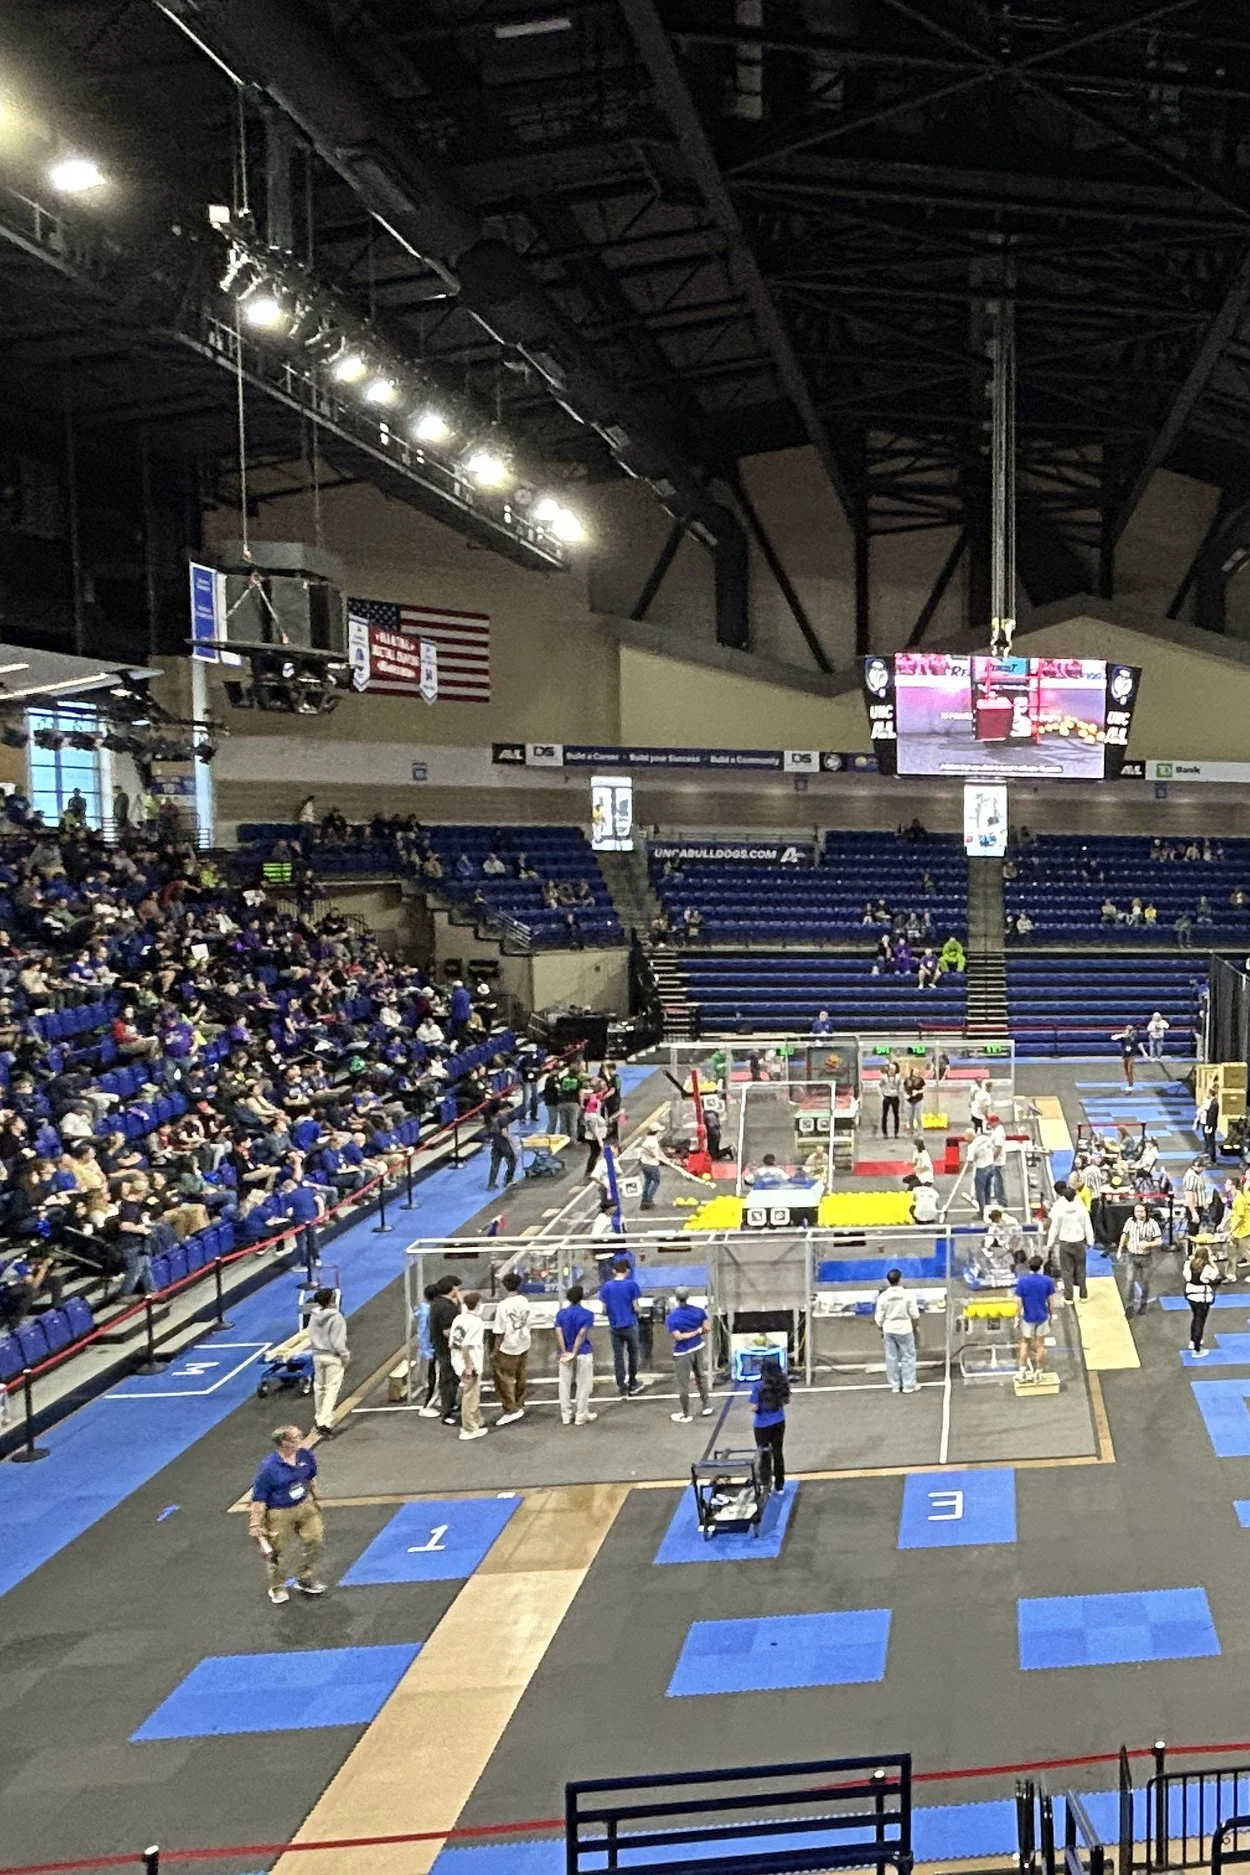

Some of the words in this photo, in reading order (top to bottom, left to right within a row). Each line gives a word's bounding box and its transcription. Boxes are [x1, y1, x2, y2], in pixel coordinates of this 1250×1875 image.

[870, 704, 894, 719] UNC
[1176, 766, 1200, 774] Bank
[654, 849, 777, 860] UNCABULLDOGS.COM
[407, 1524, 449, 1553] 1
